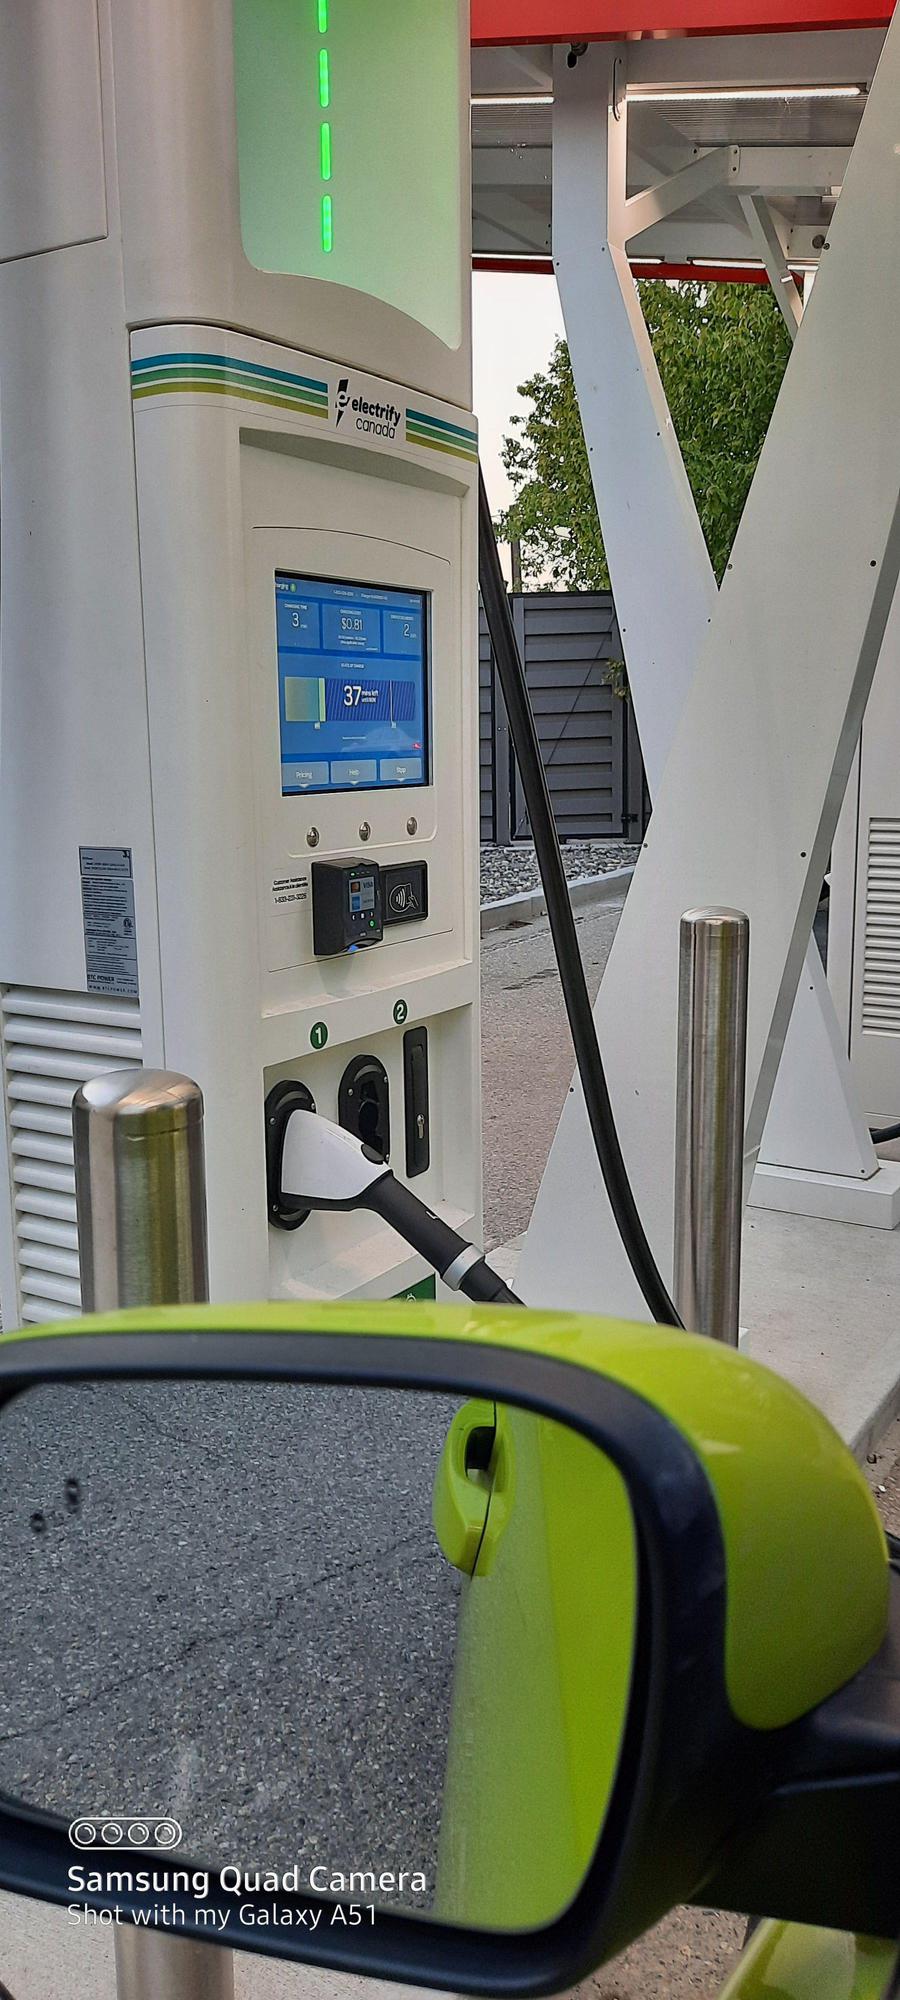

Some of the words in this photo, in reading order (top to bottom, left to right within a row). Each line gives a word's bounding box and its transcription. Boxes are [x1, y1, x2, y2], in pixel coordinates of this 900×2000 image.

[351, 396, 401, 427] electrify
[355, 417, 396, 439] canada
[292, 612, 299, 627] 3
[341, 616, 363, 631] $0.81
[403, 623, 410, 637] 2
[343, 685, 362, 706] 37
[296, 771, 313, 780] Pricing
[396, 1003, 405, 1021] 2
[315, 1027, 322, 1044] 1
